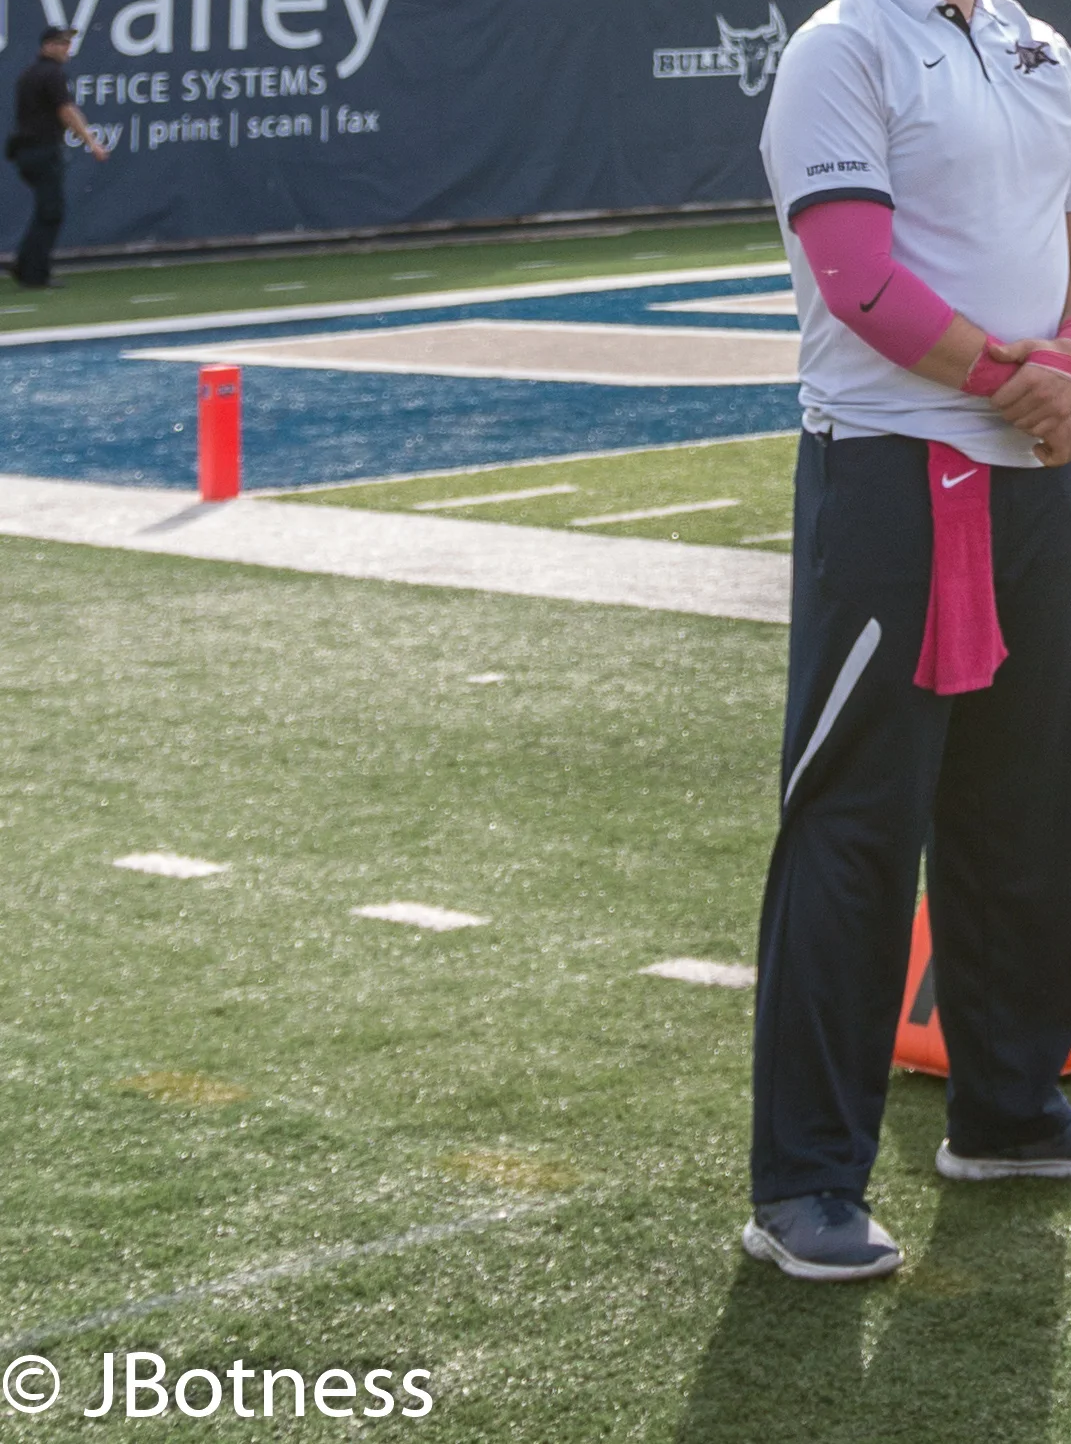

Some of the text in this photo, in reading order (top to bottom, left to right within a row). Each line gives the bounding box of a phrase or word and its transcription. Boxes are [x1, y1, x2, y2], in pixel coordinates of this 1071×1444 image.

[658, 50, 739, 75] BULLS
[67, 65, 327, 105] FFICE SYSTEMS
[149, 113, 222, 150] print
[247, 113, 312, 140] scan
[337, 104, 380, 135] fax
[806, 160, 870, 177] UTAH STATE
